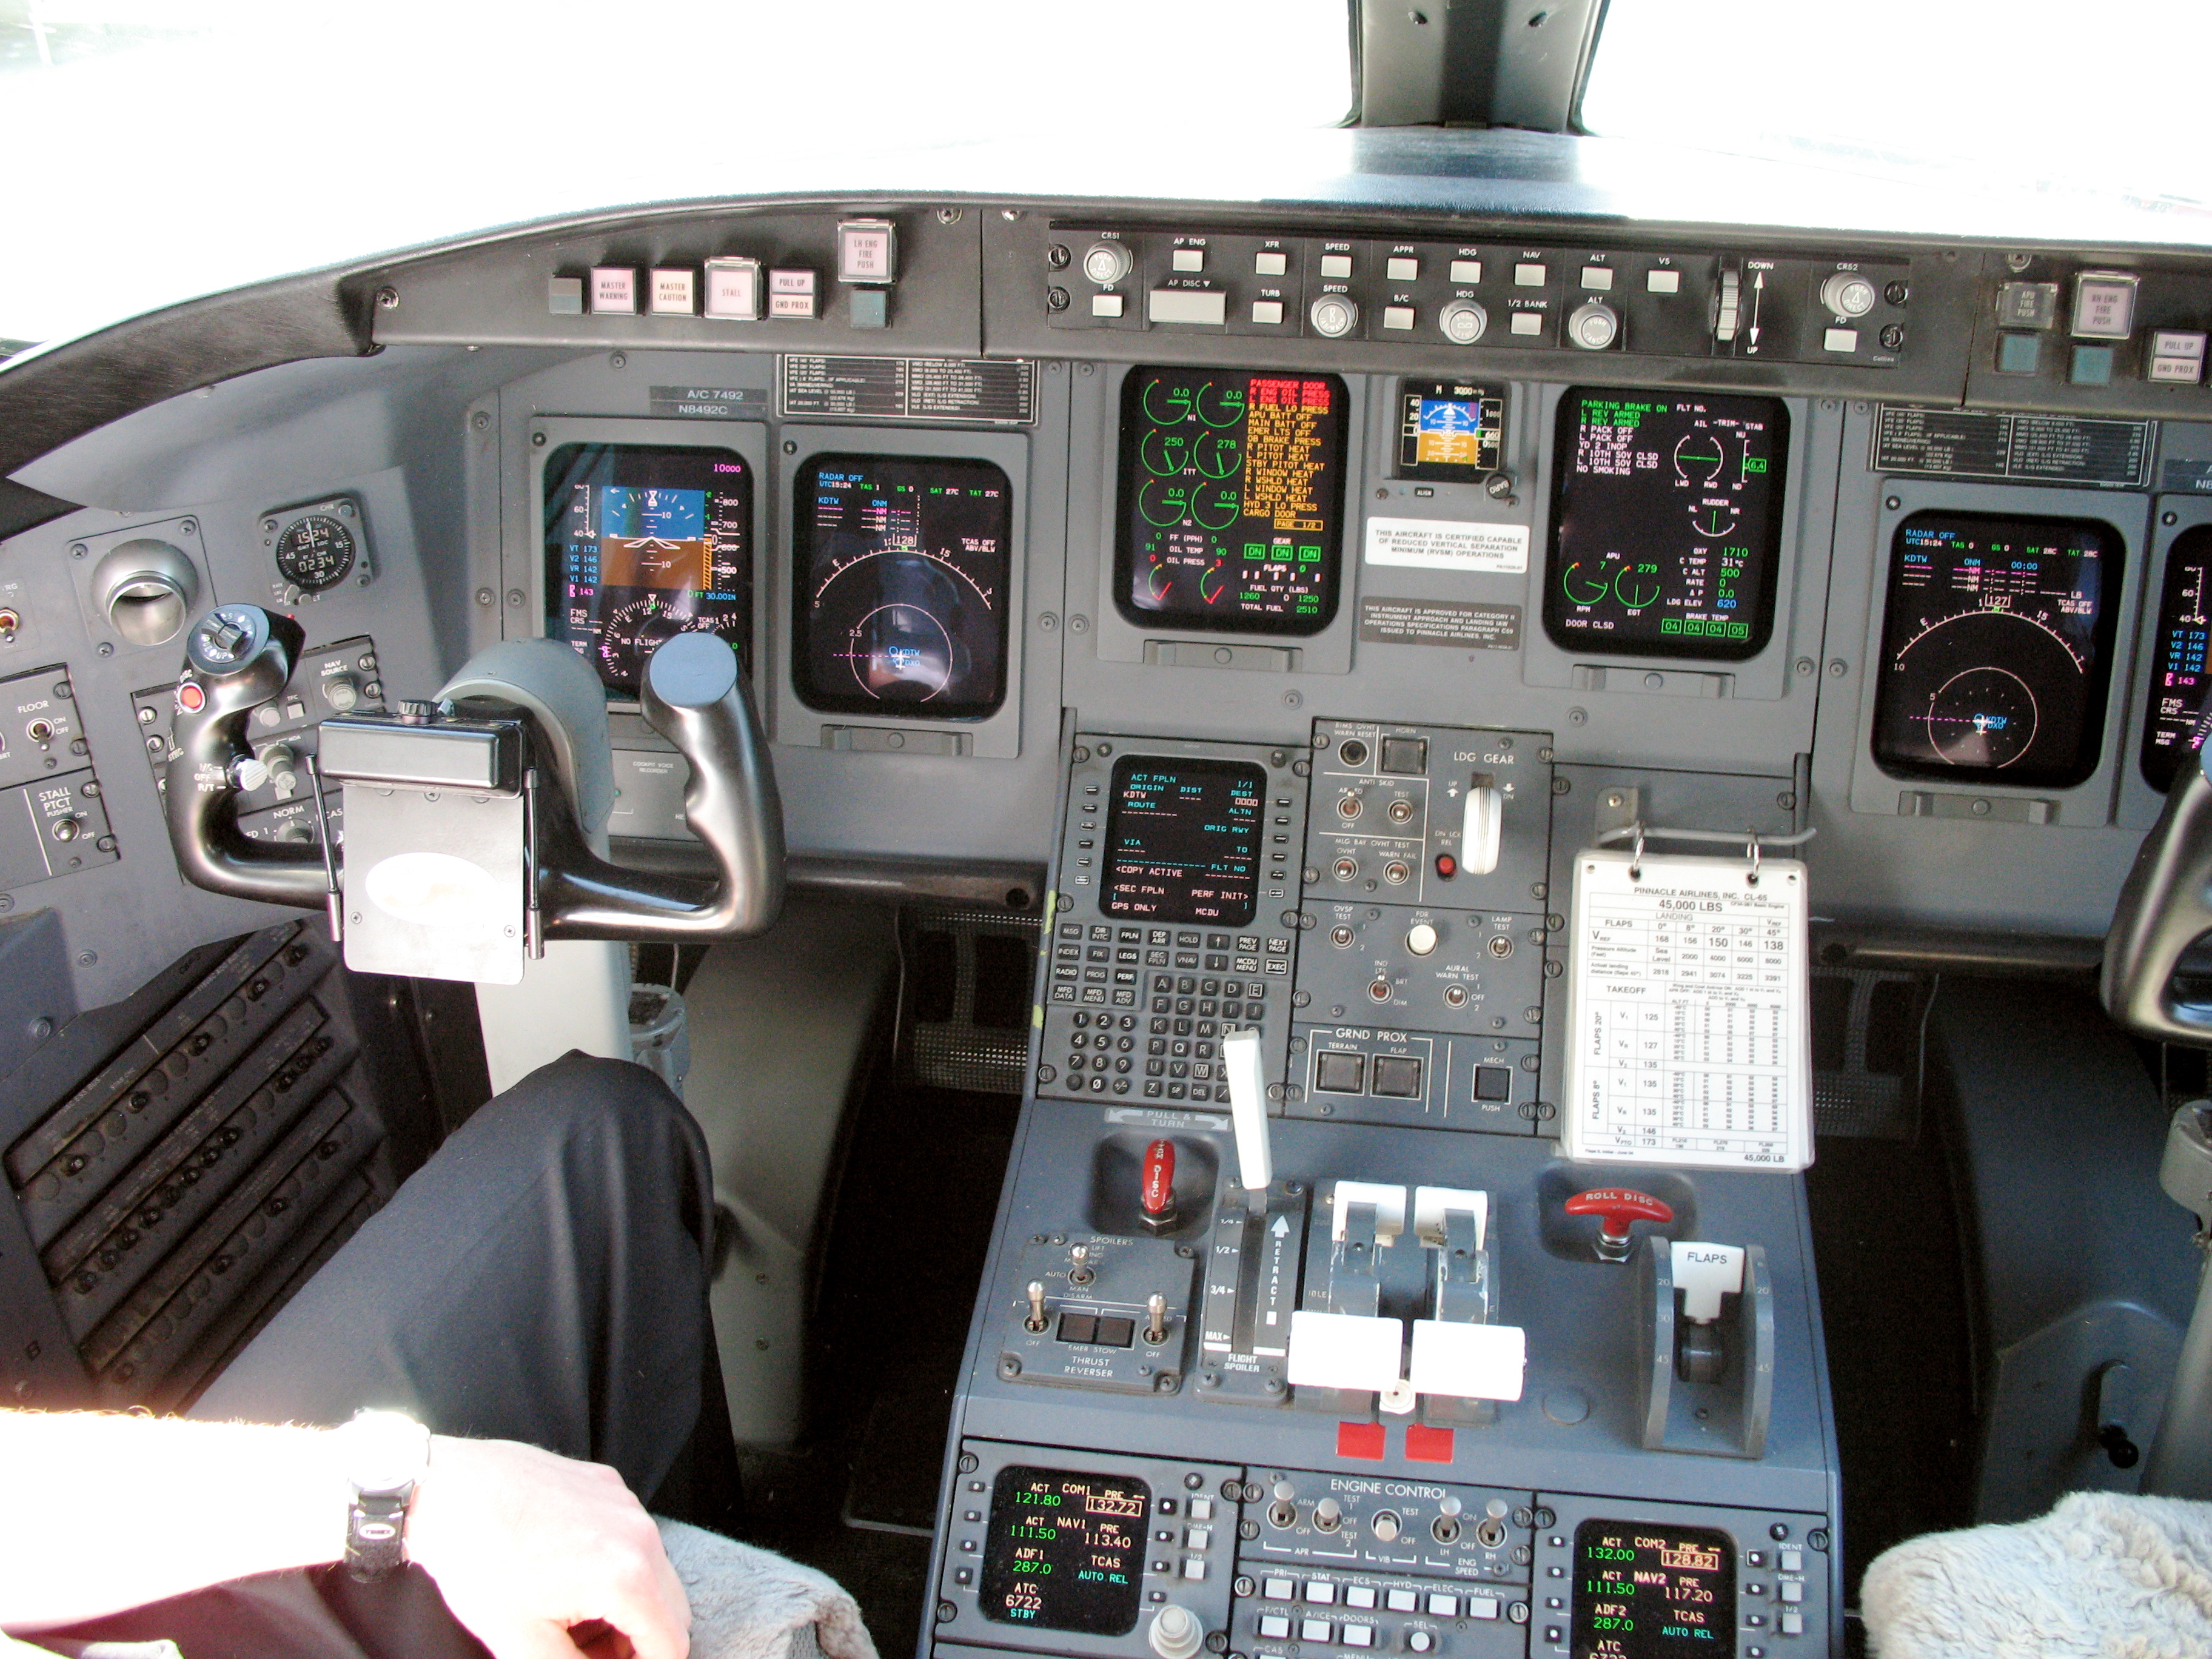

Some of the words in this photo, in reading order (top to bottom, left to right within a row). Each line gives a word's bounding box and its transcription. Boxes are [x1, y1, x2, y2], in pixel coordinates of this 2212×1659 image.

[865, 240, 877, 249] ENG
[1458, 248, 1477, 256] HDG
[1523, 251, 1541, 260] NAV
[1589, 254, 1606, 263] ALT
[1748, 261, 1774, 270] DOWN
[599, 292, 628, 301] WARNING
[659, 293, 687, 301] CAUTION
[791, 301, 809, 310] PROX
[686, 390, 709, 400] A/C
[712, 390, 743, 400] 7492
[679, 404, 728, 415] N8492C
[1582, 400, 1620, 410] PARKING
[1624, 403, 1651, 412] BRAKE
[1165, 438, 1184, 446] 250
[1218, 440, 1236, 449] 278
[714, 464, 741, 472] 10000
[1594, 466, 1631, 475] SMOKING
[819, 472, 846, 481] RADAR
[1446, 533, 1484, 541] CERTIFIED
[1906, 530, 1934, 538] RADAR
[896, 535, 914, 545] 128
[1456, 551, 1504, 559] OPERATIONS
[1638, 564, 1657, 573] 279
[18, 700, 49, 714] FLOOR
[1454, 752, 1475, 762] LDG
[1484, 754, 1514, 764] GEAR
[39, 787, 72, 802] STALL
[43, 797, 70, 811] PTCT
[1149, 868, 1182, 877] ACTIVE
[1191, 890, 1214, 898] PERF
[1634, 887, 1676, 896] PINNACLE
[1680, 890, 1721, 899] AIRLINES,
[1659, 899, 1696, 911] 45,000
[1700, 902, 1723, 911] LBS
[1196, 908, 1219, 916] MCDU
[1605, 919, 1632, 928] FLAPS
[1709, 937, 1728, 947] 150
[1764, 940, 1783, 950] 138
[1446, 964, 1469, 973] AURAL
[1607, 985, 1646, 994] TAKEOFF
[1336, 1028, 1370, 1040] GRND
[1377, 1031, 1407, 1042] PROX
[1744, 1154, 1771, 1163] 45,000
[1586, 1192, 1617, 1201] ROLL
[1624, 1193, 1653, 1205] DISC
[1687, 1252, 1728, 1264] FLAPS
[1269, 1241, 1282, 1306] RETRACT
[1205, 1331, 1222, 1341] MAX
[1072, 1356, 1110, 1367] THRUST
[1228, 1353, 1258, 1364] FLIGHT
[1064, 1367, 1113, 1378] REVERSER
[1224, 1362, 1259, 1373] SPOILER
[1031, 1483, 1050, 1493] ACT
[1062, 1483, 1091, 1495] COM1
[1330, 1478, 1381, 1495] ENGINE
[1015, 1491, 1061, 1506] 121.80
[1089, 1498, 1136, 1514] 132.72
[1011, 1525, 1056, 1540] 111.50
[1084, 1532, 1131, 1549] 113.40
[1015, 1547, 1044, 1560] ADF1
[1587, 1546, 1635, 1561] 132.00
[1091, 1555, 1121, 1569] TCAS
[1665, 1552, 1713, 1567] 128.82
[1013, 1560, 1051, 1575] 287.0
[1079, 1570, 1104, 1581] AUTO
[1110, 1574, 1128, 1584] REL
[1312, 1572, 1331, 1581] STAT
[1014, 1583, 1037, 1594] ATC
[1393, 1581, 1412, 1589] HYD
[1432, 1584, 1453, 1593] ELEC
[1587, 1580, 1635, 1595] 111.50
[1473, 1588, 1495, 1597] FUEL
[1665, 1587, 1713, 1603] 117.20
[1005, 1595, 1042, 1609] 6722
[1010, 1609, 1036, 1619] STBY
[1343, 1614, 1375, 1624] DOORS
